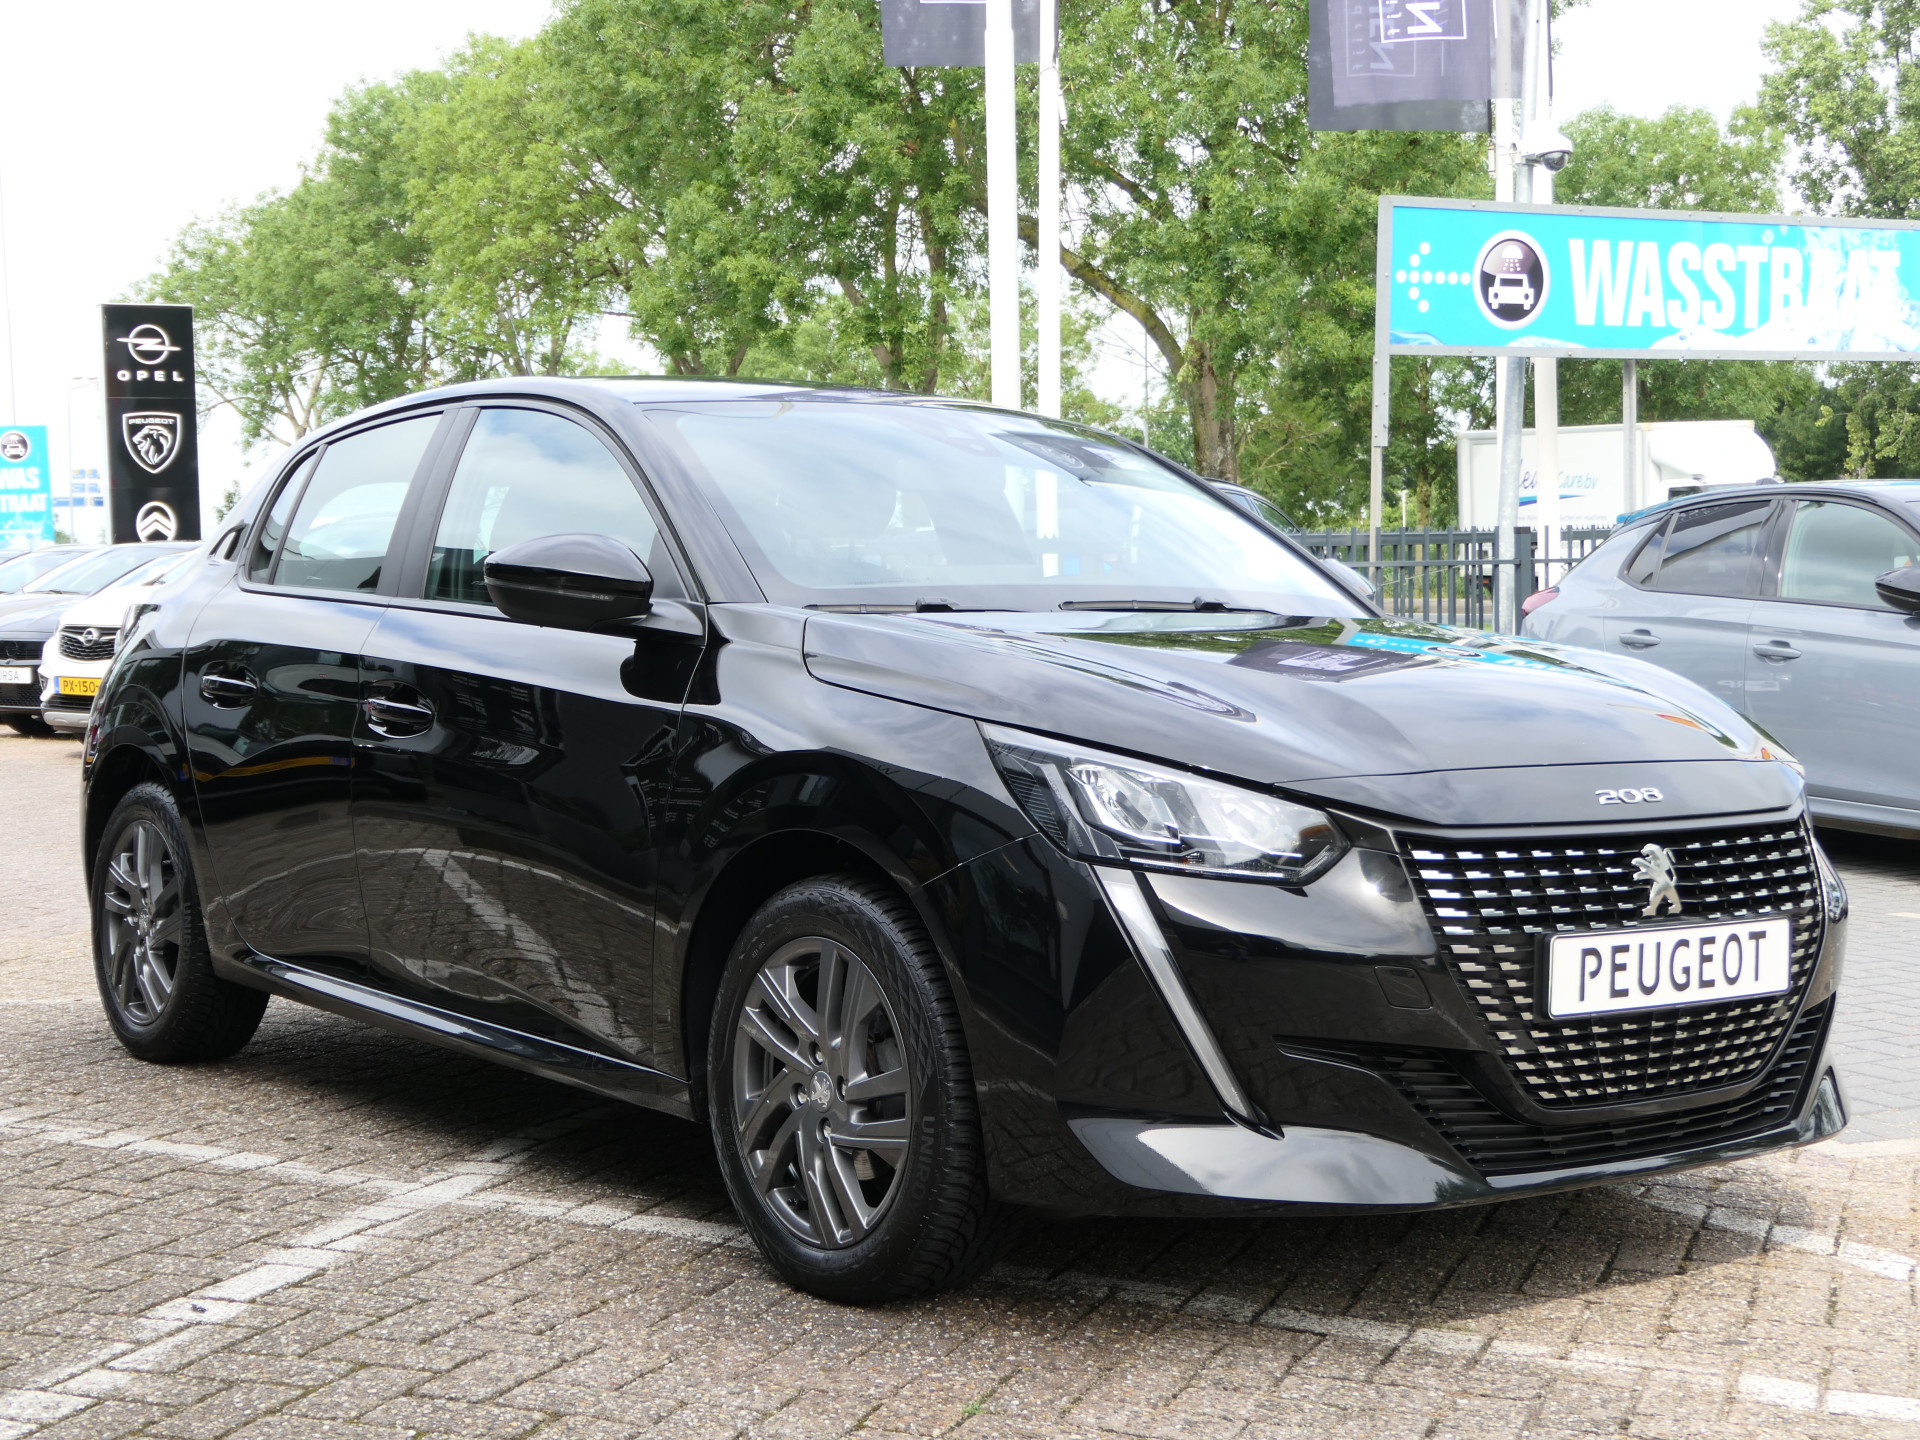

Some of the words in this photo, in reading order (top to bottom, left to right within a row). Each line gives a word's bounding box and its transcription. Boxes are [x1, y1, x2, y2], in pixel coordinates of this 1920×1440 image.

[1568, 238, 1900, 330] WASSTRAAT
[117, 370, 184, 381] OPEL
[128, 417, 175, 425] PEUGEOT
[0, 670, 20, 681] RSA
[1594, 787, 1664, 805] 208
[1579, 930, 1767, 1002] PEUGEOT
